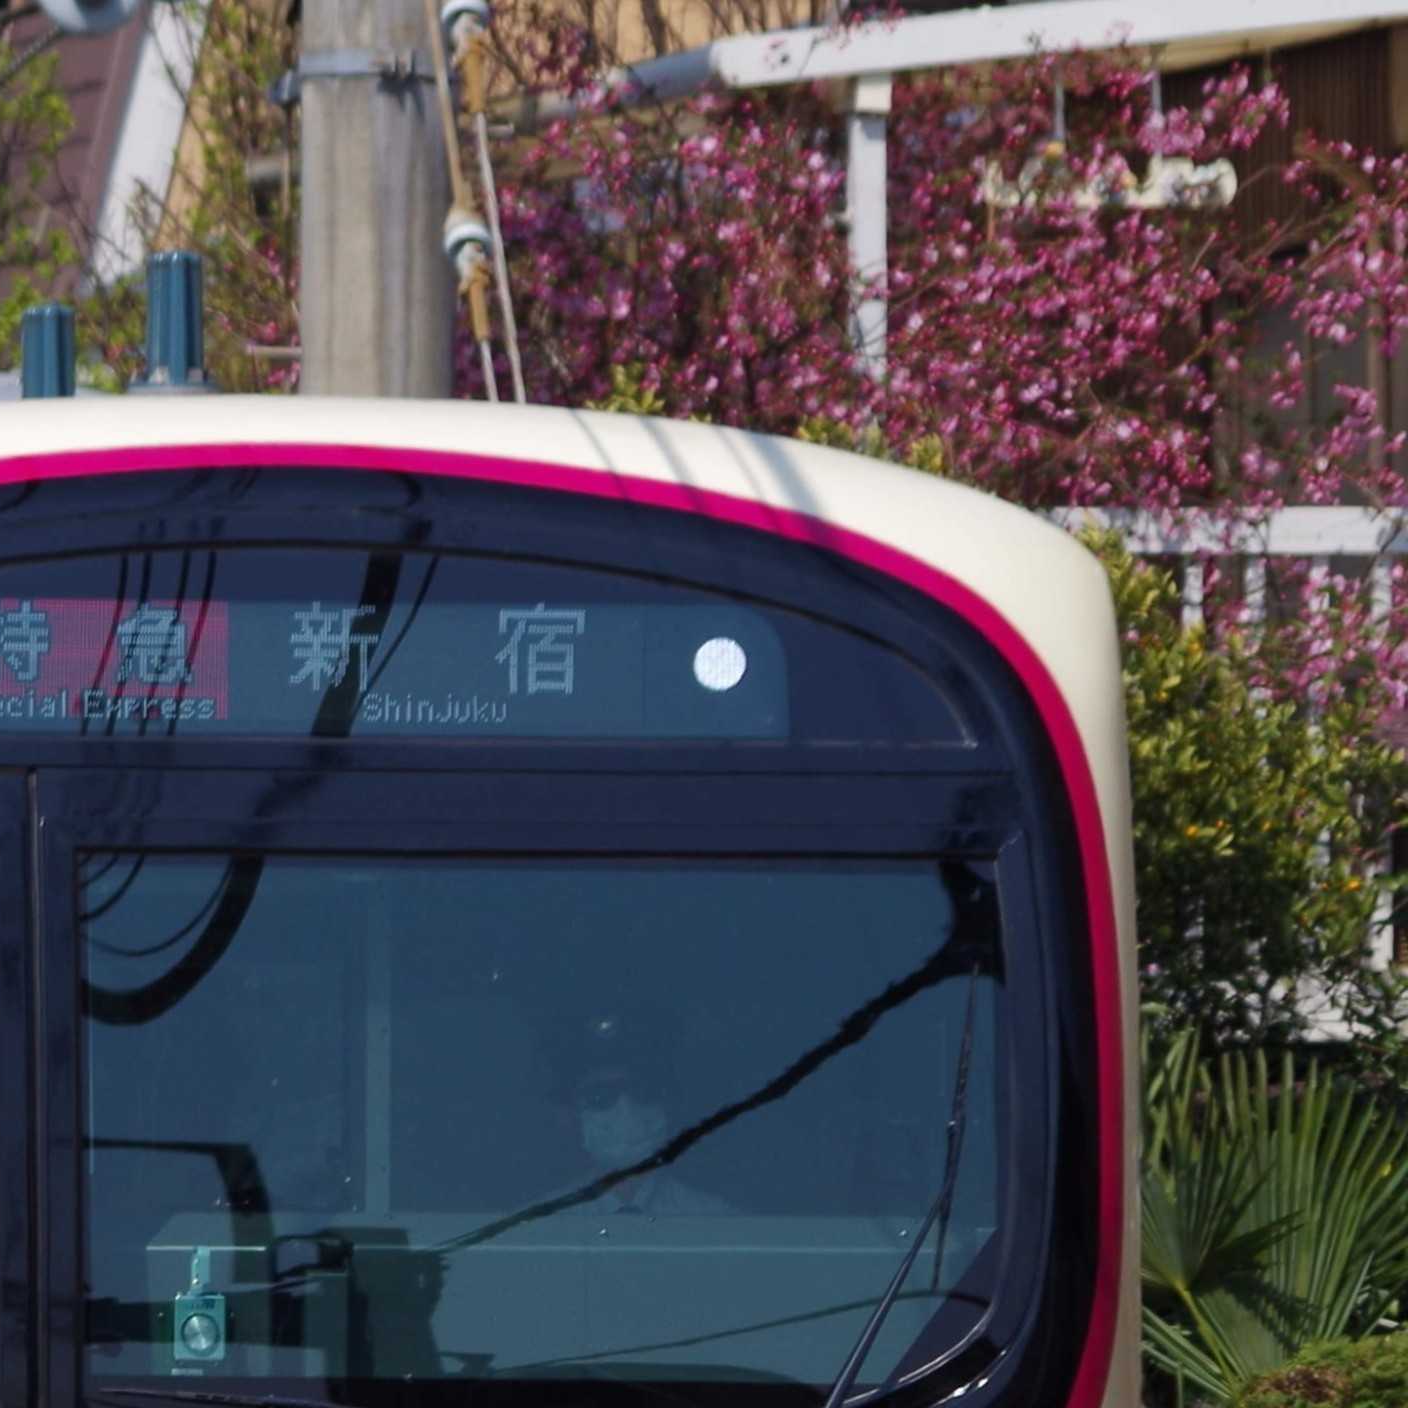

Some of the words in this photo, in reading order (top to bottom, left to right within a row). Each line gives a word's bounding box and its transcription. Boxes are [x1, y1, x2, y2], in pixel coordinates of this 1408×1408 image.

[290, 601, 585, 693] 新宿
[84, 688, 215, 719] Express
[363, 693, 507, 722] Shinjuku
